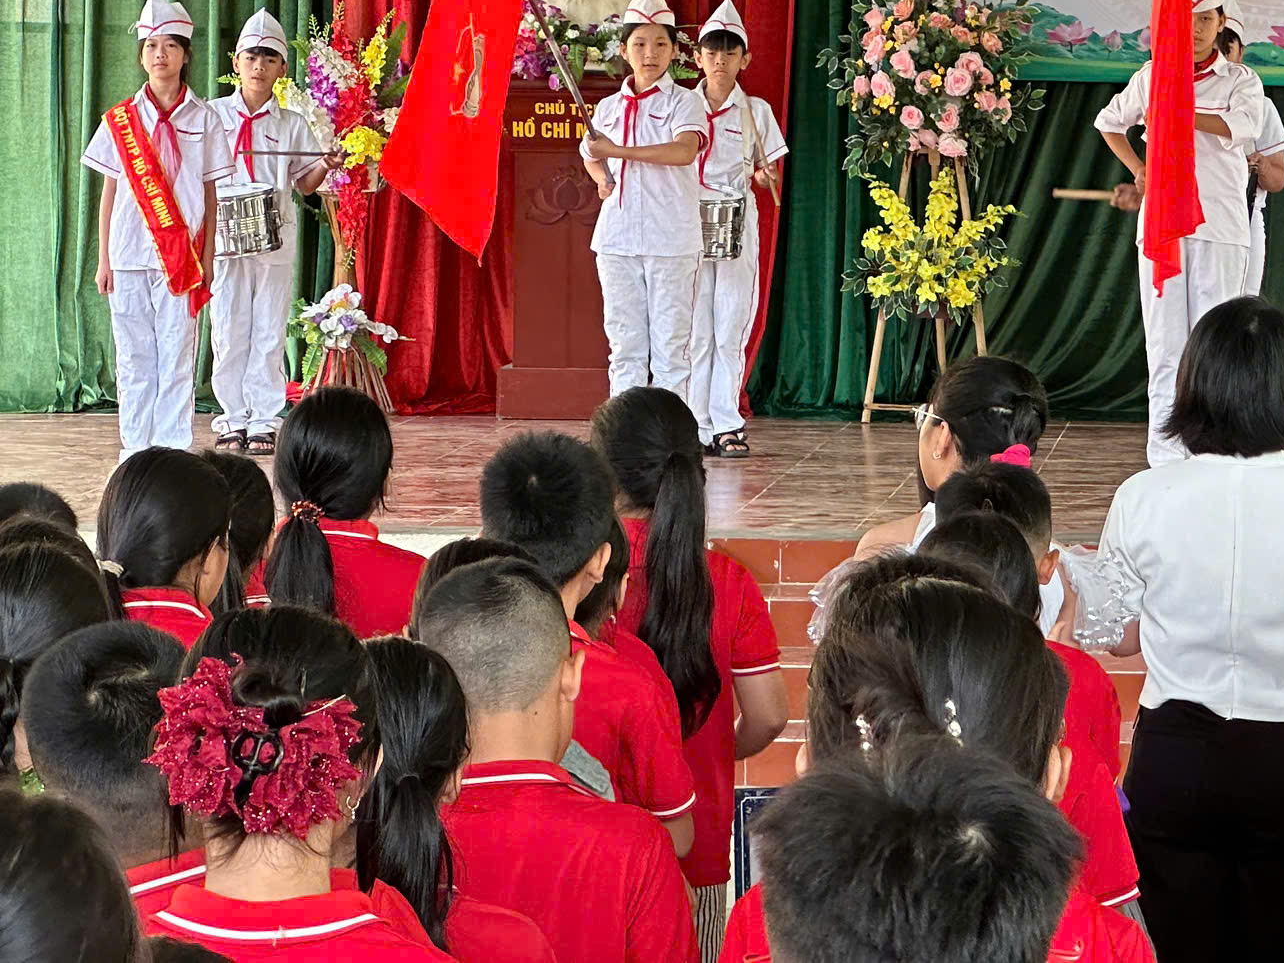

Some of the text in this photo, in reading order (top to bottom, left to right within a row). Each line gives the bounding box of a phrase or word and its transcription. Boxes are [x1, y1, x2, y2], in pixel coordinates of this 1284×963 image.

[534, 99, 565, 115] CHỦ
[512, 116, 536, 138] HỒ
[541, 119, 570, 139] CHÍ
[121, 128, 141, 156] TNTP
[151, 196, 174, 229] MINH
